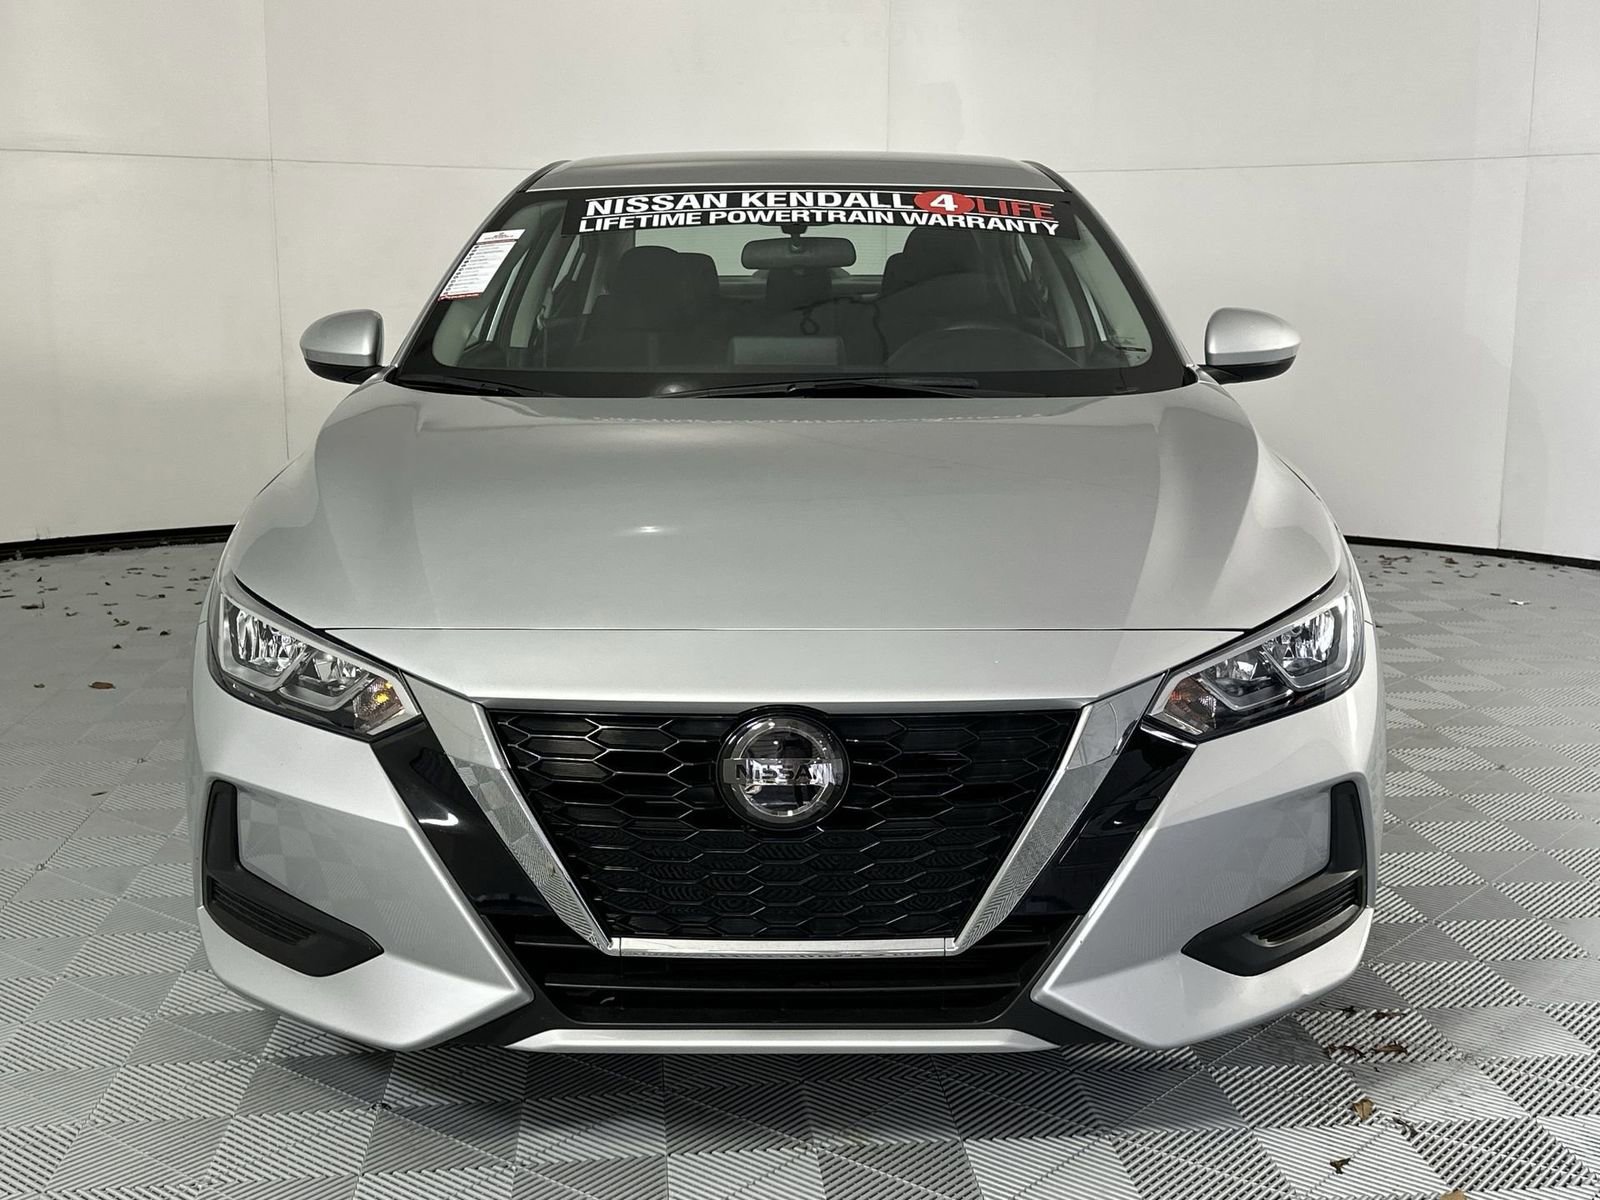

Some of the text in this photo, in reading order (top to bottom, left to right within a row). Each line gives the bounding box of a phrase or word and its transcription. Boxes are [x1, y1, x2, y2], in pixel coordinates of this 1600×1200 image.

[585, 192, 1053, 219] NISSAN KENDALL 4 LIFE
[578, 210, 1059, 236] LIFETIME POWERTRAIN WARRANTY
